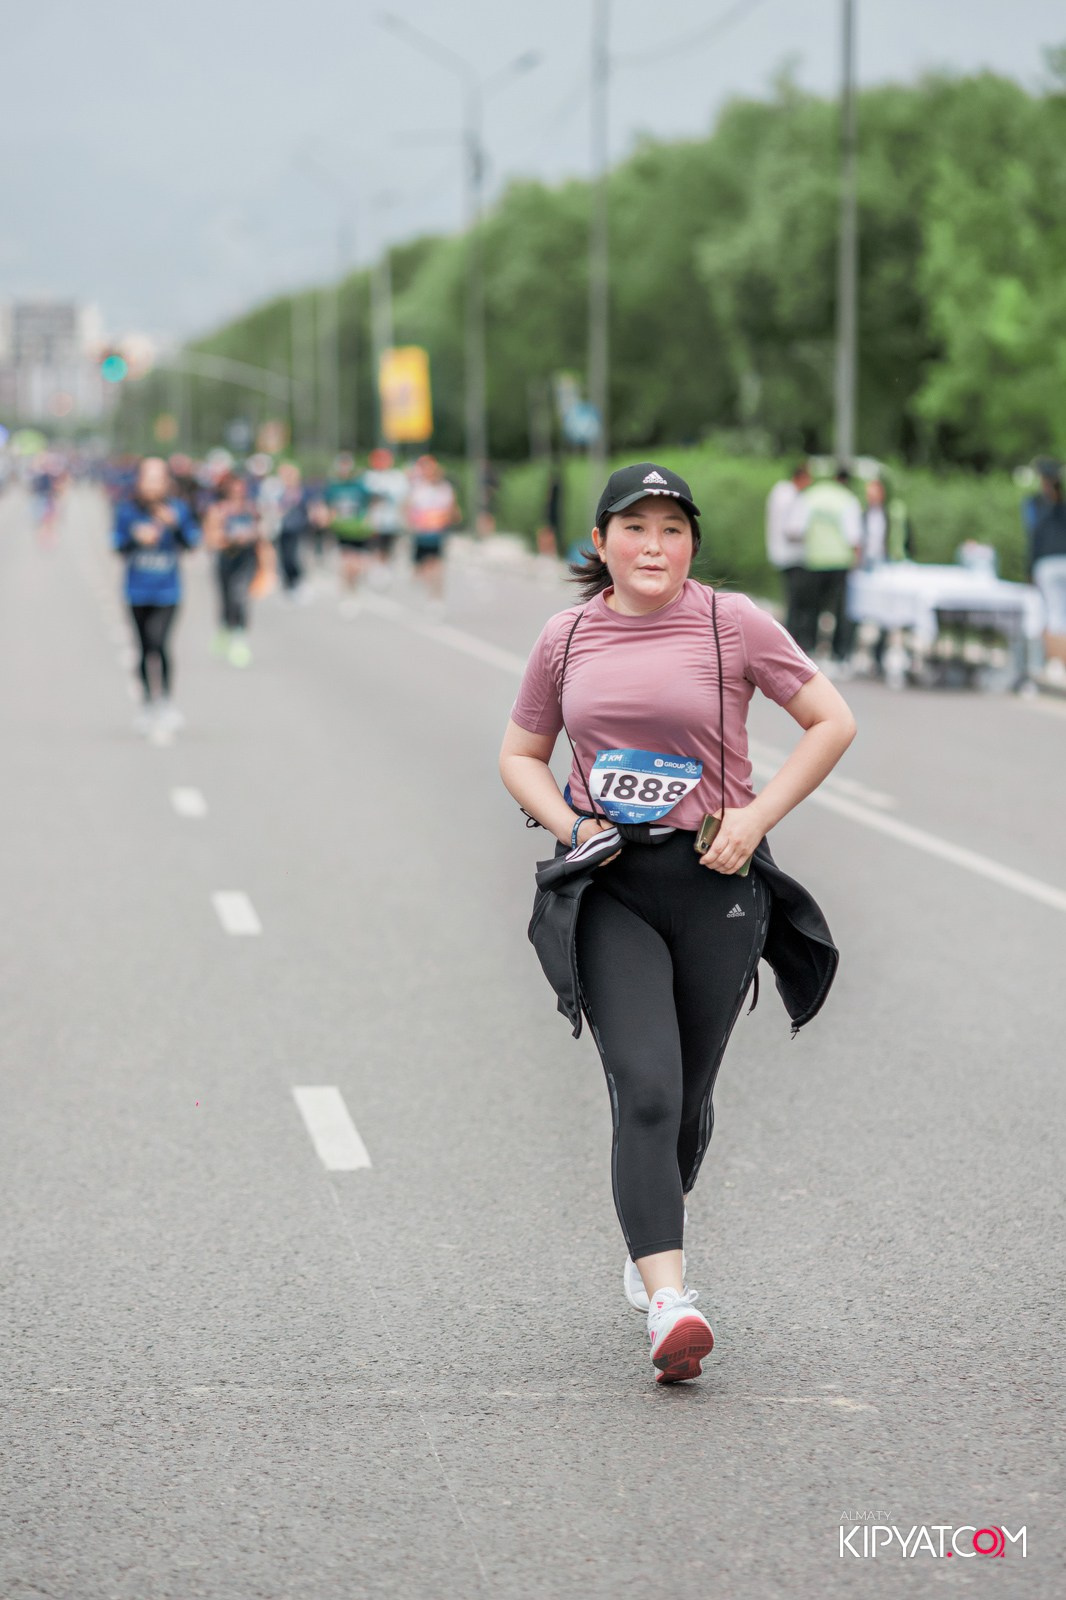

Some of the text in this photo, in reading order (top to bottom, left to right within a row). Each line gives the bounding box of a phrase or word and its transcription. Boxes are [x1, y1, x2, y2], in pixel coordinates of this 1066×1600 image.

[600, 754, 606, 762] 5
[664, 761, 686, 769] GROUP
[600, 772, 687, 803] 1888
